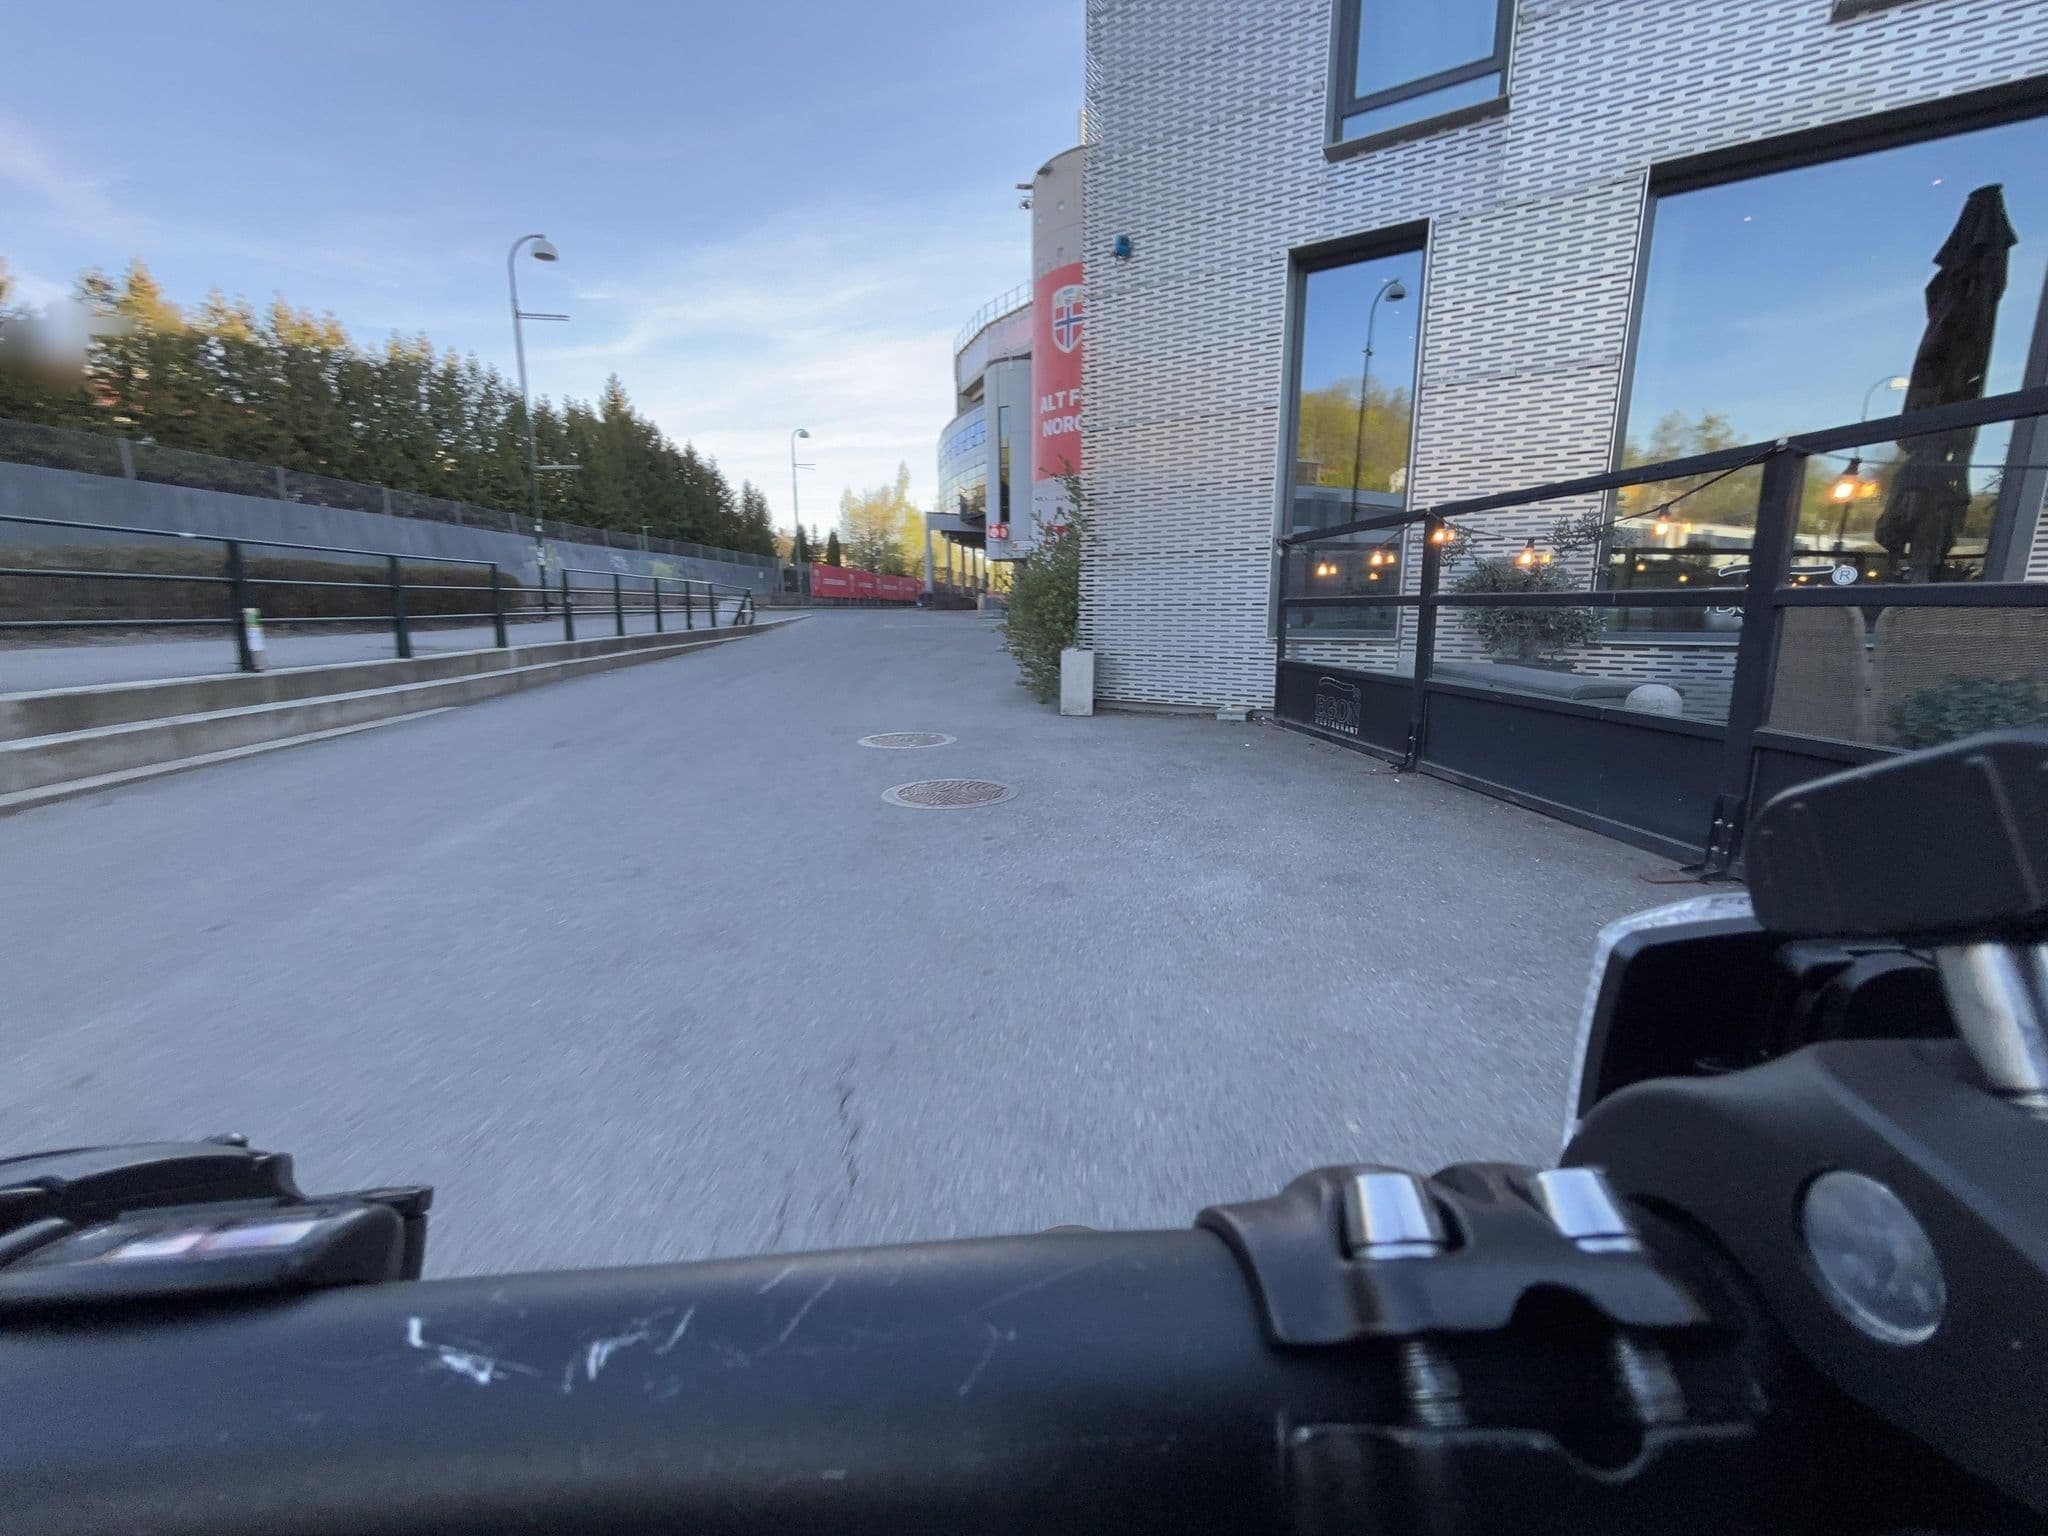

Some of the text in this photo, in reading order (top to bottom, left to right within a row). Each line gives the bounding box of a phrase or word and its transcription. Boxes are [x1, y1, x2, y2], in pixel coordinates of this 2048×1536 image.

[1040, 391, 1067, 414] ALT
[1315, 694, 1361, 727] EGON
[1314, 717, 1359, 735] RESTAURANT
